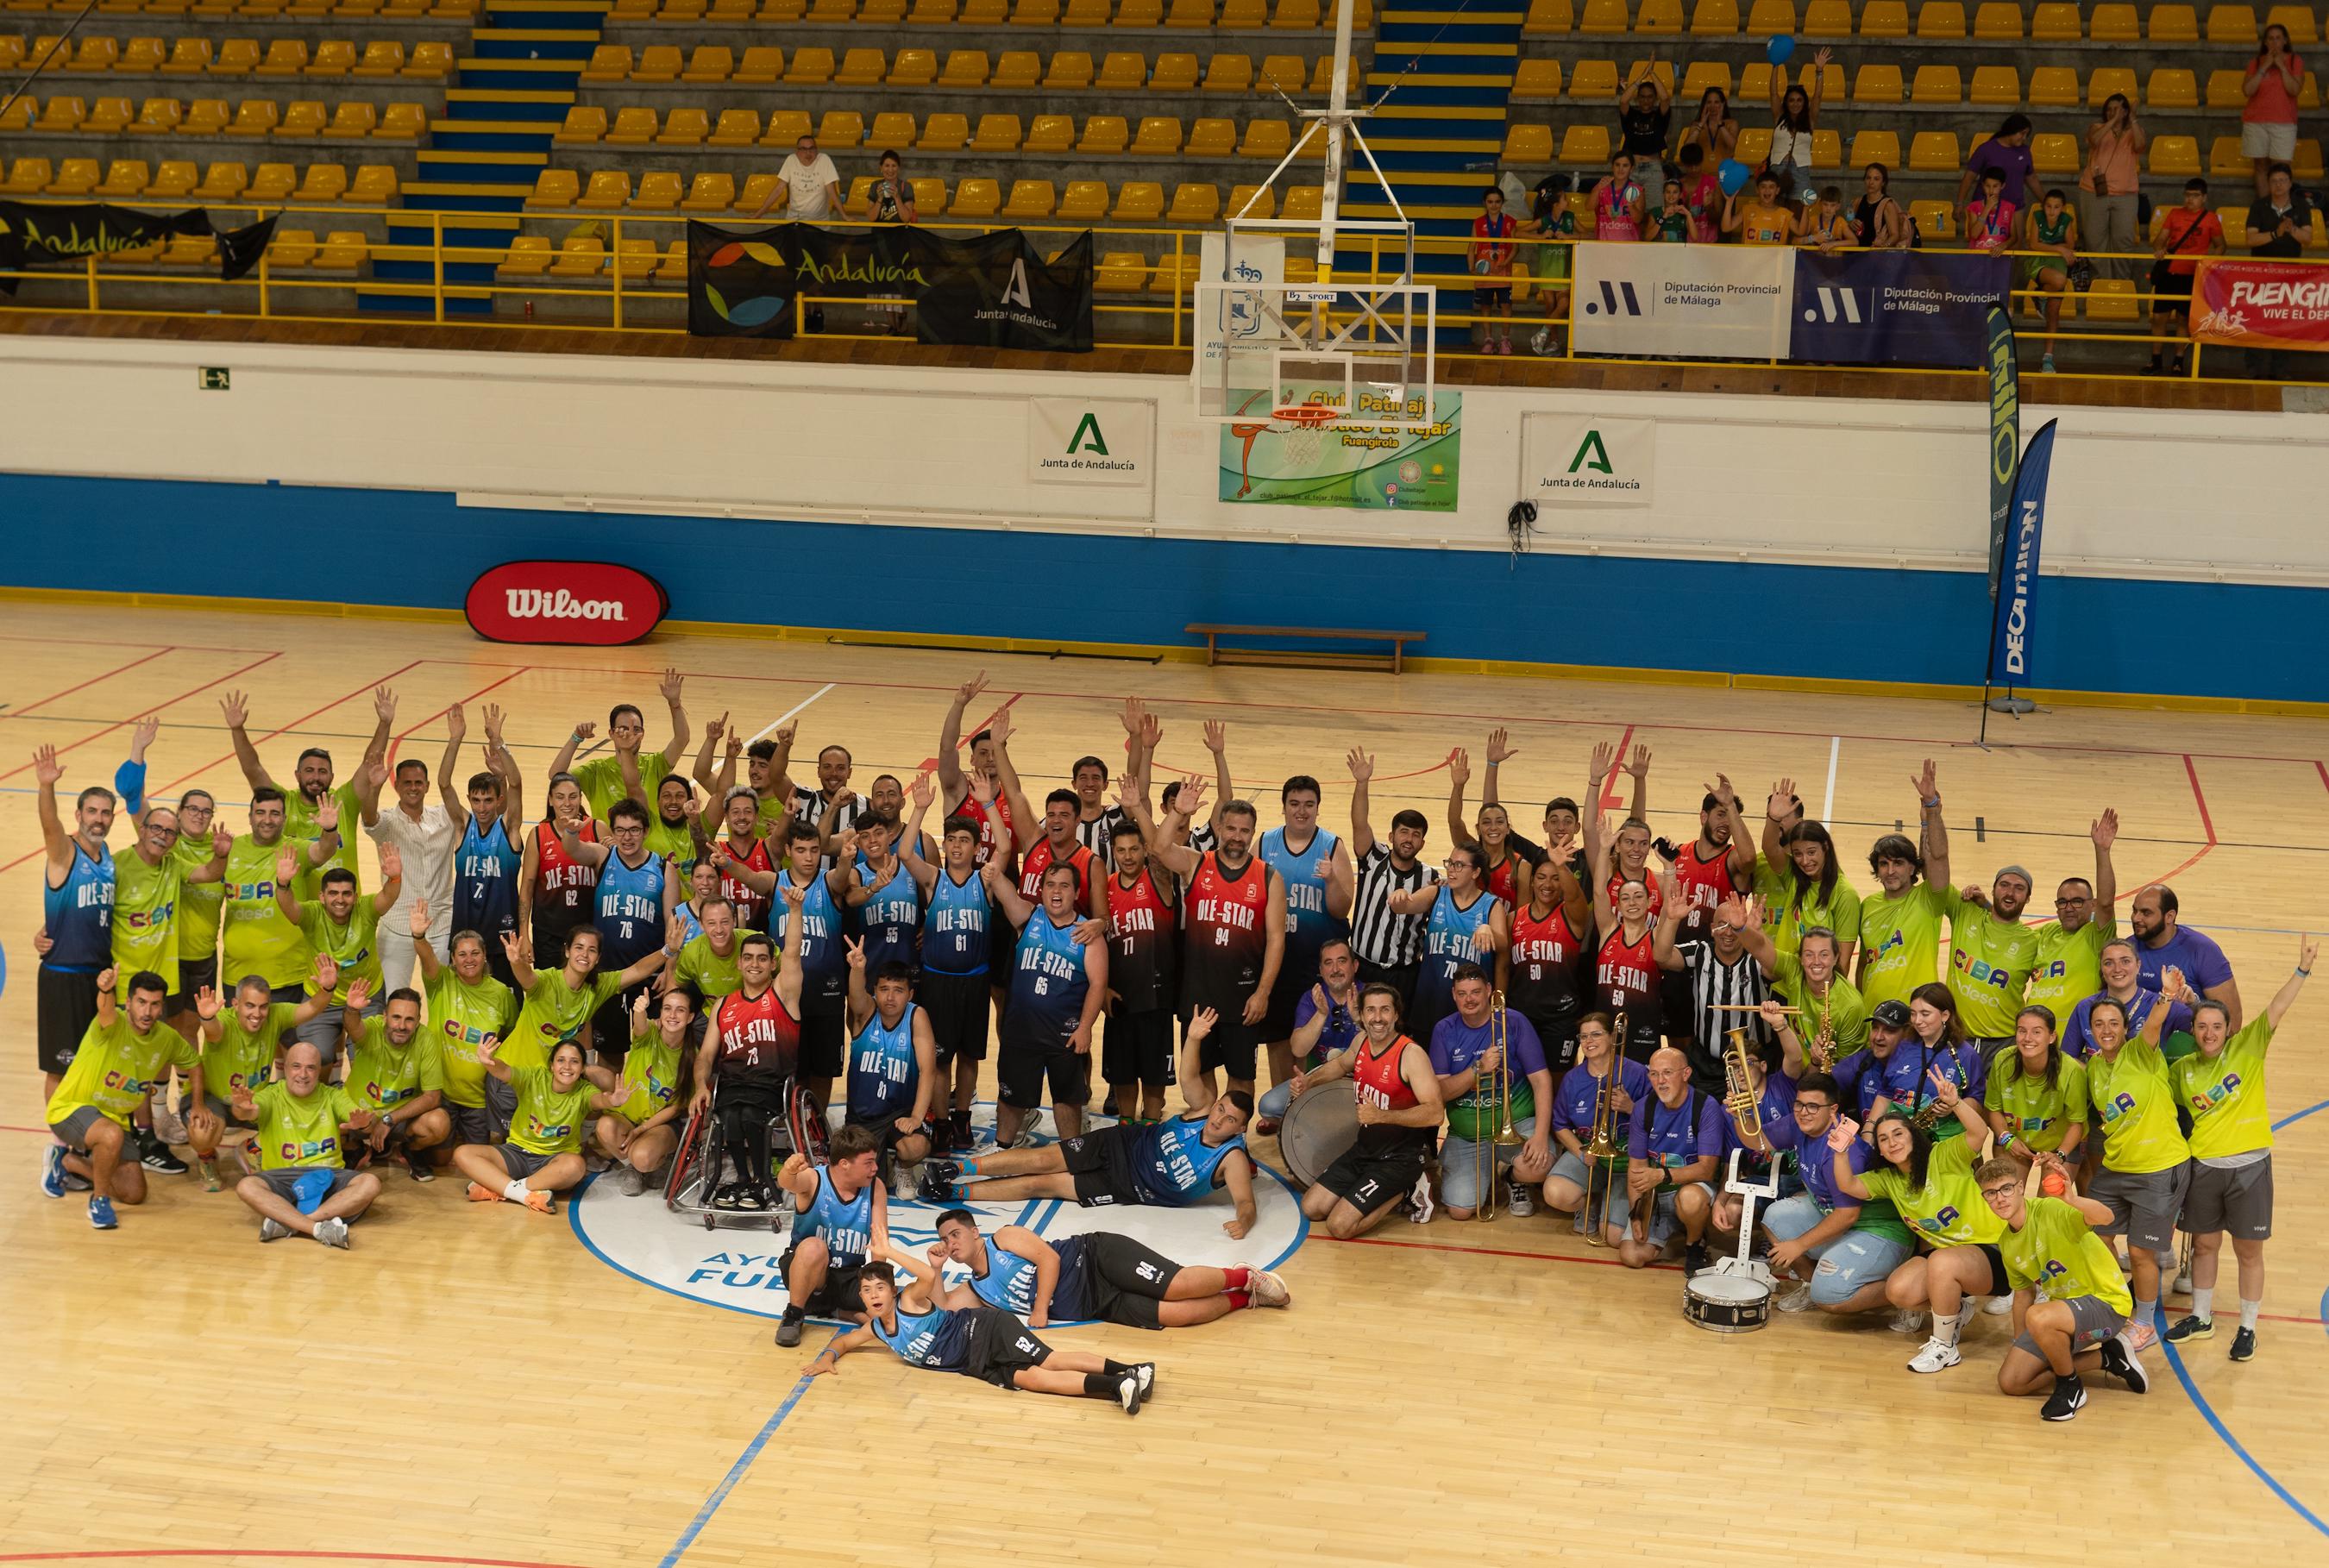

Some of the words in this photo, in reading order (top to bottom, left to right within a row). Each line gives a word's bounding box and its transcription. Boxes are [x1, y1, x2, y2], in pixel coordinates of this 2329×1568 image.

[795, 248, 931, 287] Andalucía
[1664, 281, 1723, 293] Diputación
[1727, 284, 1781, 294] Provincial
[1884, 286, 1943, 300] Diputación
[1945, 291, 2000, 304] Provincial
[1664, 295, 1677, 304] de
[1680, 295, 1721, 307] Málaga
[1883, 300, 1896, 310] de
[1898, 300, 1940, 314] Málaga
[974, 309, 1005, 319] Junta
[2263, 308, 2289, 319] VIVE
[2292, 310, 2305, 320] EL
[1342, 434, 1399, 449] Fuengirola
[1040, 458, 1069, 468] Junta
[1071, 459, 1083, 468] de
[1085, 460, 1135, 470] Andalucía
[1541, 478, 1570, 487] Junta
[1573, 478, 1585, 488] de
[1587, 479, 1640, 490] Andalucía
[505, 588, 625, 622] Wilson
[566, 889, 578, 906] 62
[1196, 894, 1254, 931] OLÉ-STAR
[1687, 909, 1701, 927] 88
[619, 921, 632, 939] 76
[886, 926, 898, 944] 55
[1215, 927, 1229, 946] 94
[955, 934, 966, 951] 61
[1123, 936, 1133, 955] 77
[1020, 944, 1076, 982] OLÉ-STAR
[1529, 964, 1541, 980] 50
[1954, 948, 2009, 989] CIBA
[1035, 975, 1048, 995] 65
[1612, 989, 1624, 1007] 59
[747, 1047, 759, 1066] 73
[1561, 1039, 1574, 1057] 50
[876, 1080, 887, 1100] 81
[2192, 1074, 2242, 1111] CIBA
[281, 1138, 336, 1159] CIBA
[1135, 1260, 1158, 1281] 84
[1014, 1336, 1035, 1353] 52
